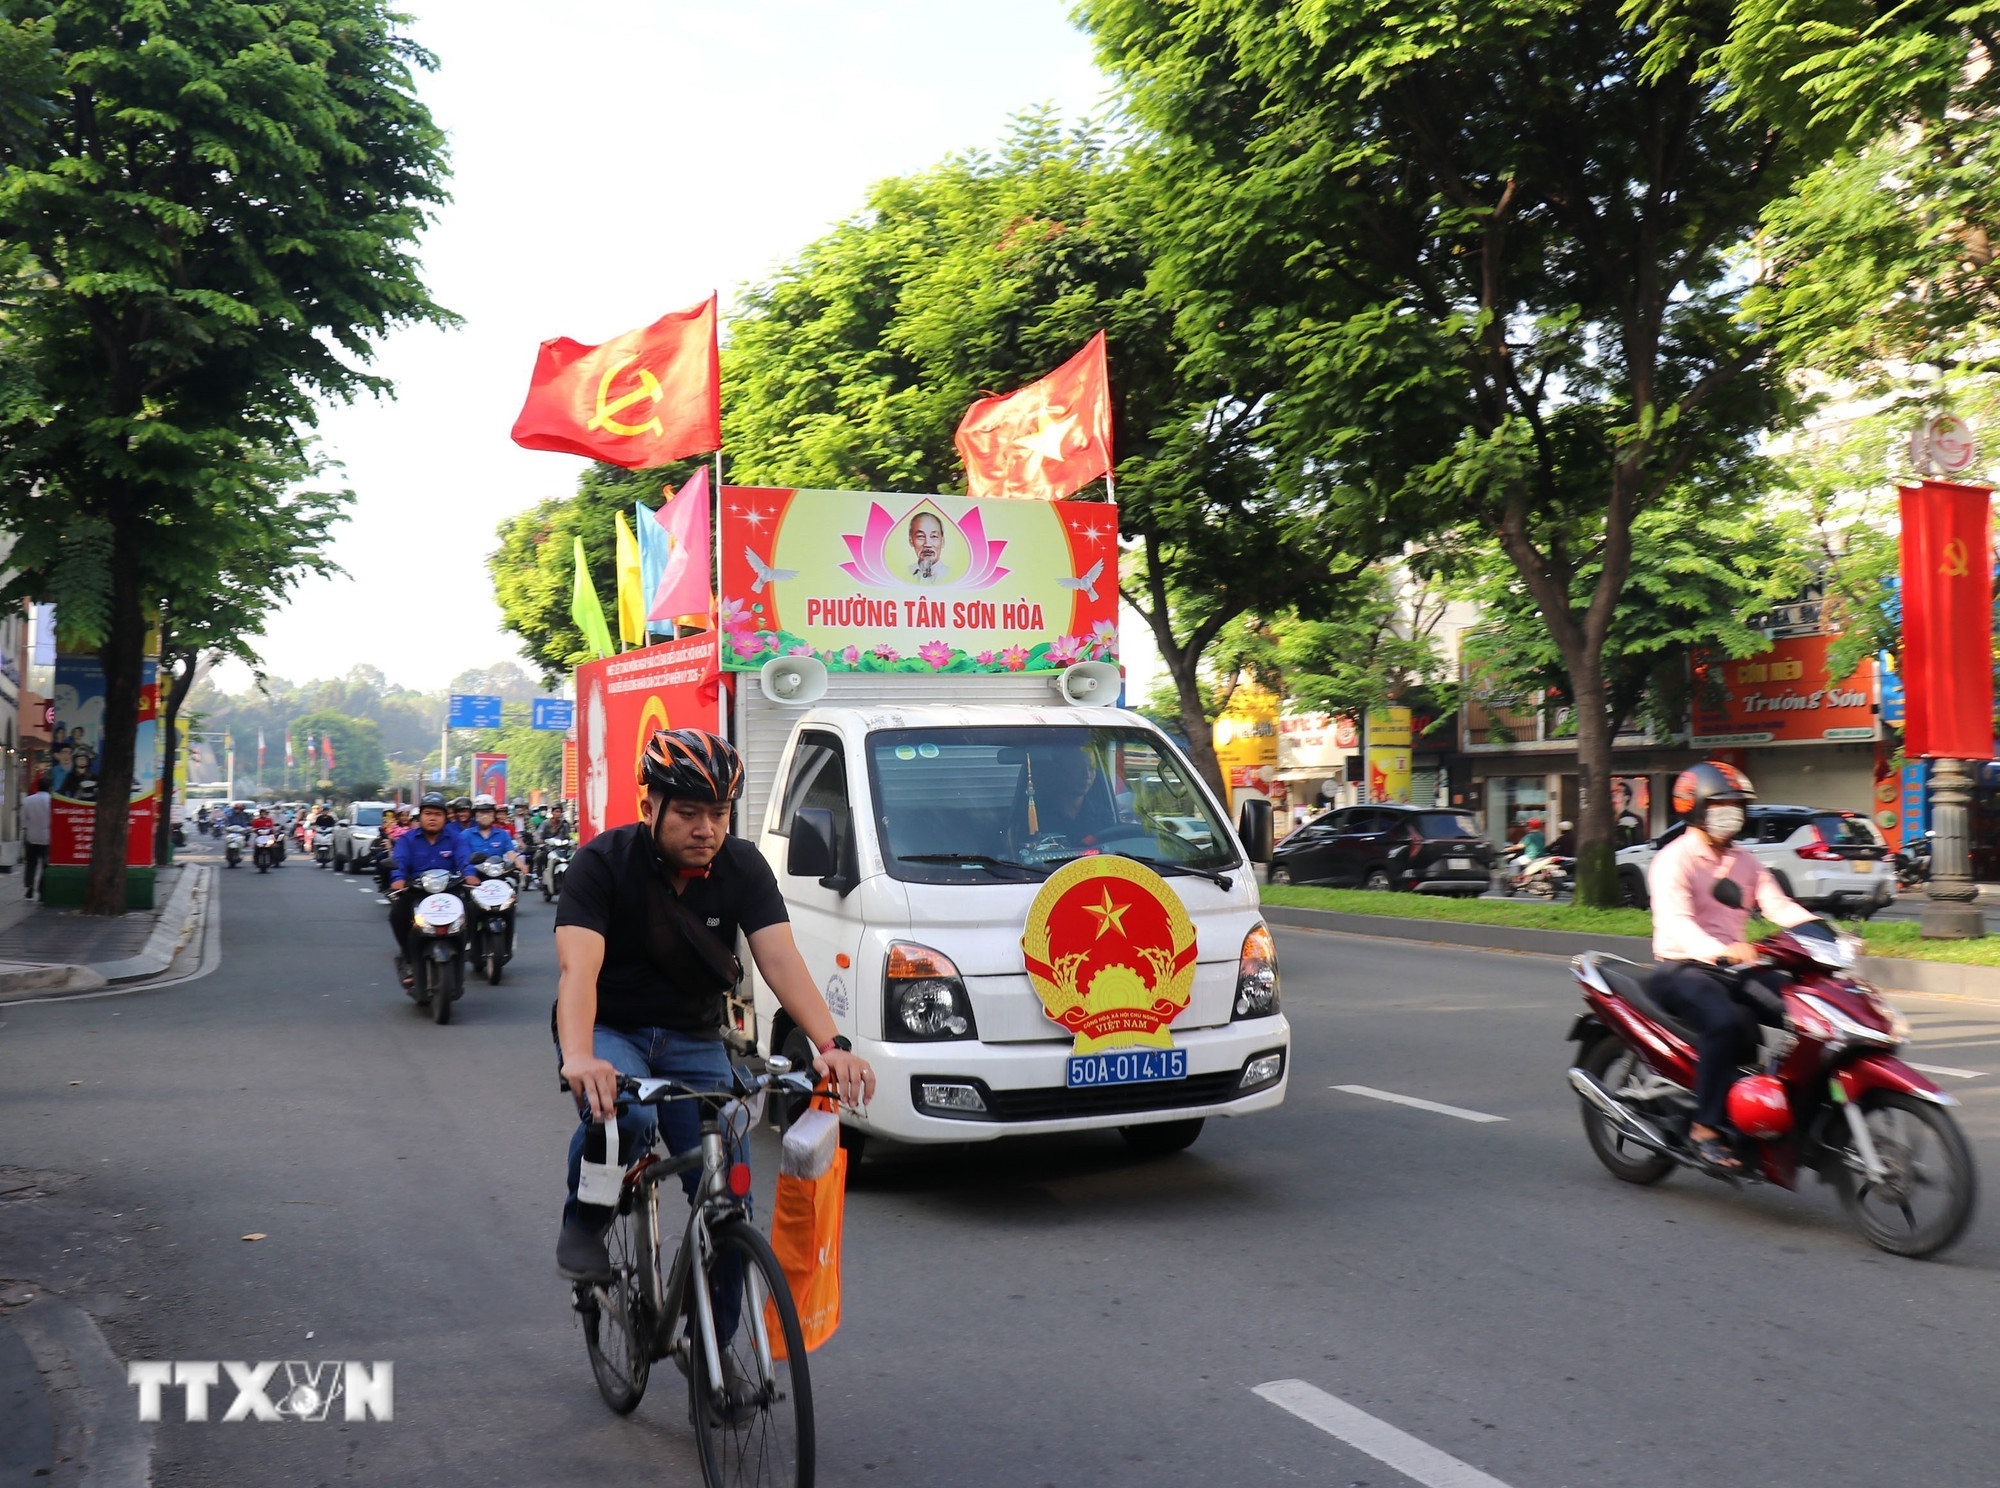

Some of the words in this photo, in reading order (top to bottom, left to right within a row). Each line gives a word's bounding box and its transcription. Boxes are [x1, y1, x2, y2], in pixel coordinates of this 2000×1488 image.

[807, 592, 897, 627] PHƯỜNG
[903, 595, 946, 629] TÂN
[952, 598, 996, 629] SƠN
[1002, 597, 1044, 631] HÒA
[1742, 688, 1826, 713] Trường
[1826, 688, 1867, 708] Sơn
[1096, 1018, 1120, 1033] VIỆT
[1123, 1020, 1147, 1029] NAM
[1072, 1052, 1183, 1084] 50A-014.15
